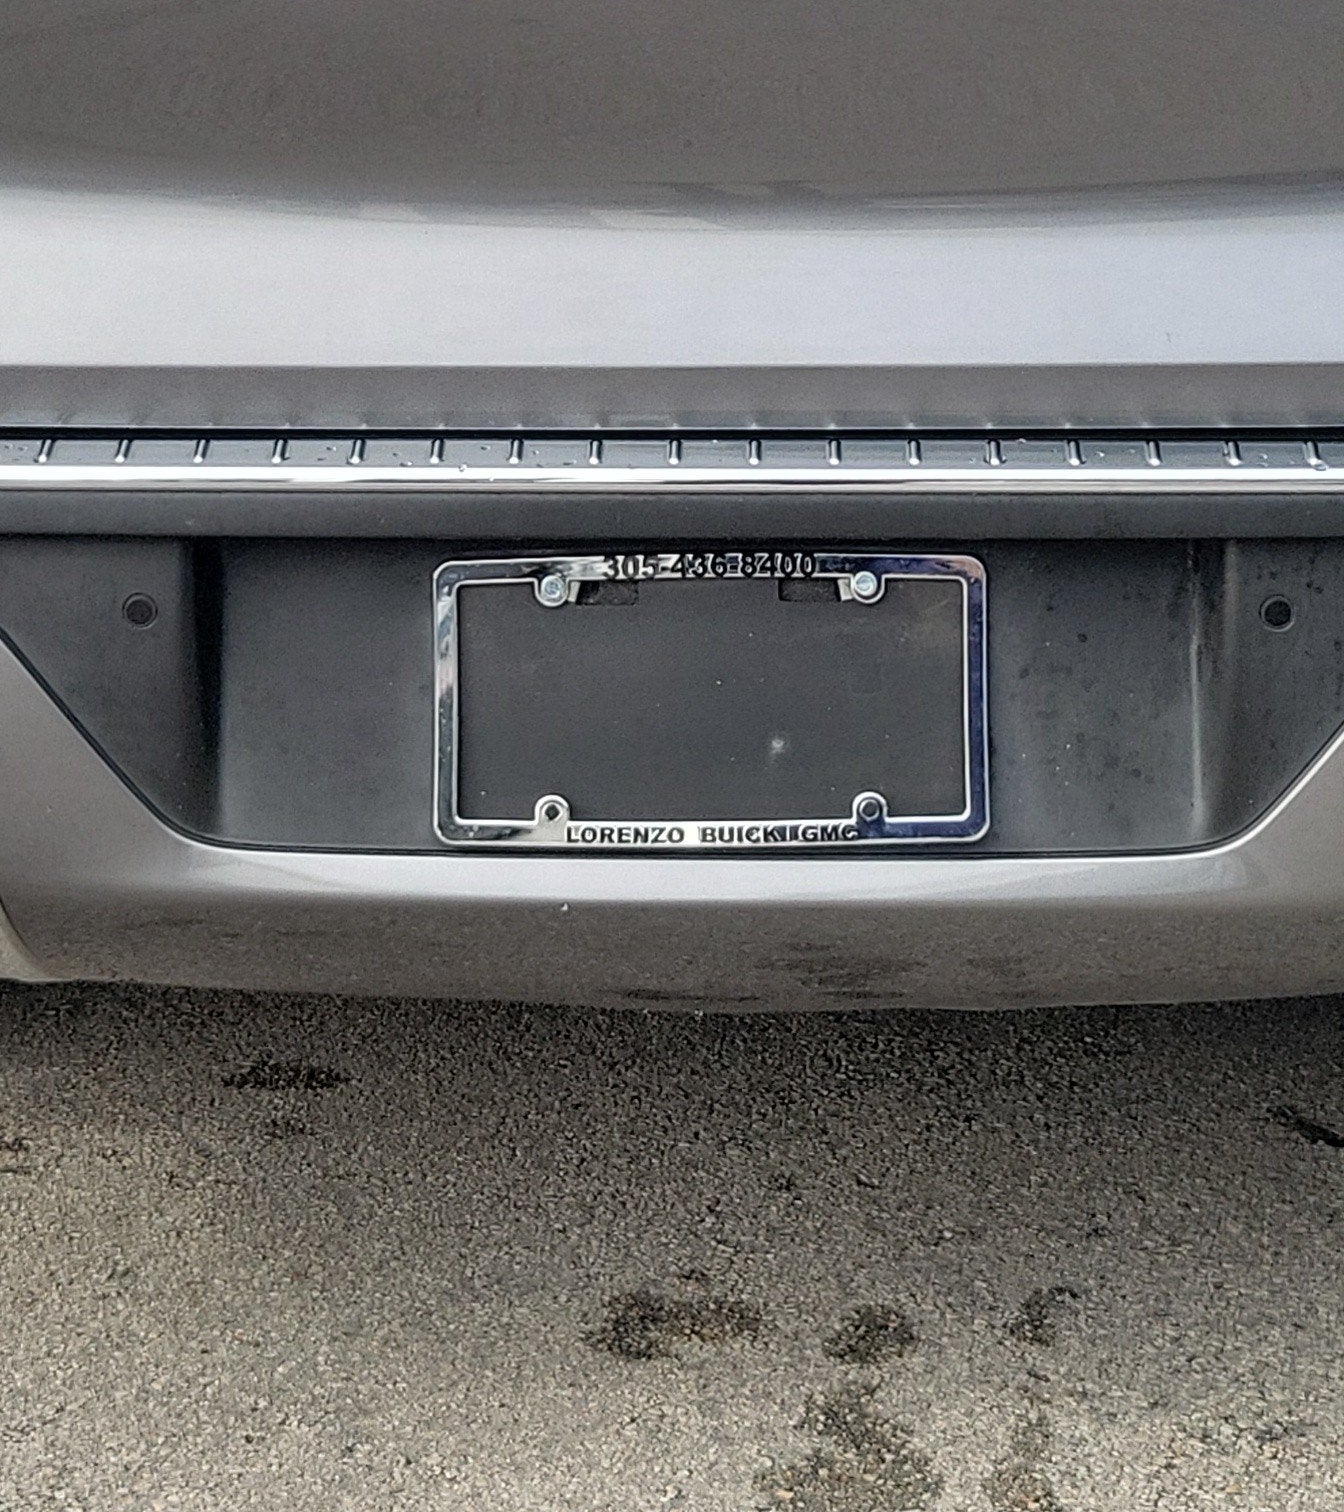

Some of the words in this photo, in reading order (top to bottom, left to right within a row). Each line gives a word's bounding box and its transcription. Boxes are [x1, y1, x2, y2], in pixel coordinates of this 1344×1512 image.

[603, 552, 817, 579] 305-436-8400
[566, 826, 685, 844] LORENZO
[700, 825, 783, 843] BUICK
[801, 823, 860, 842] GMC
